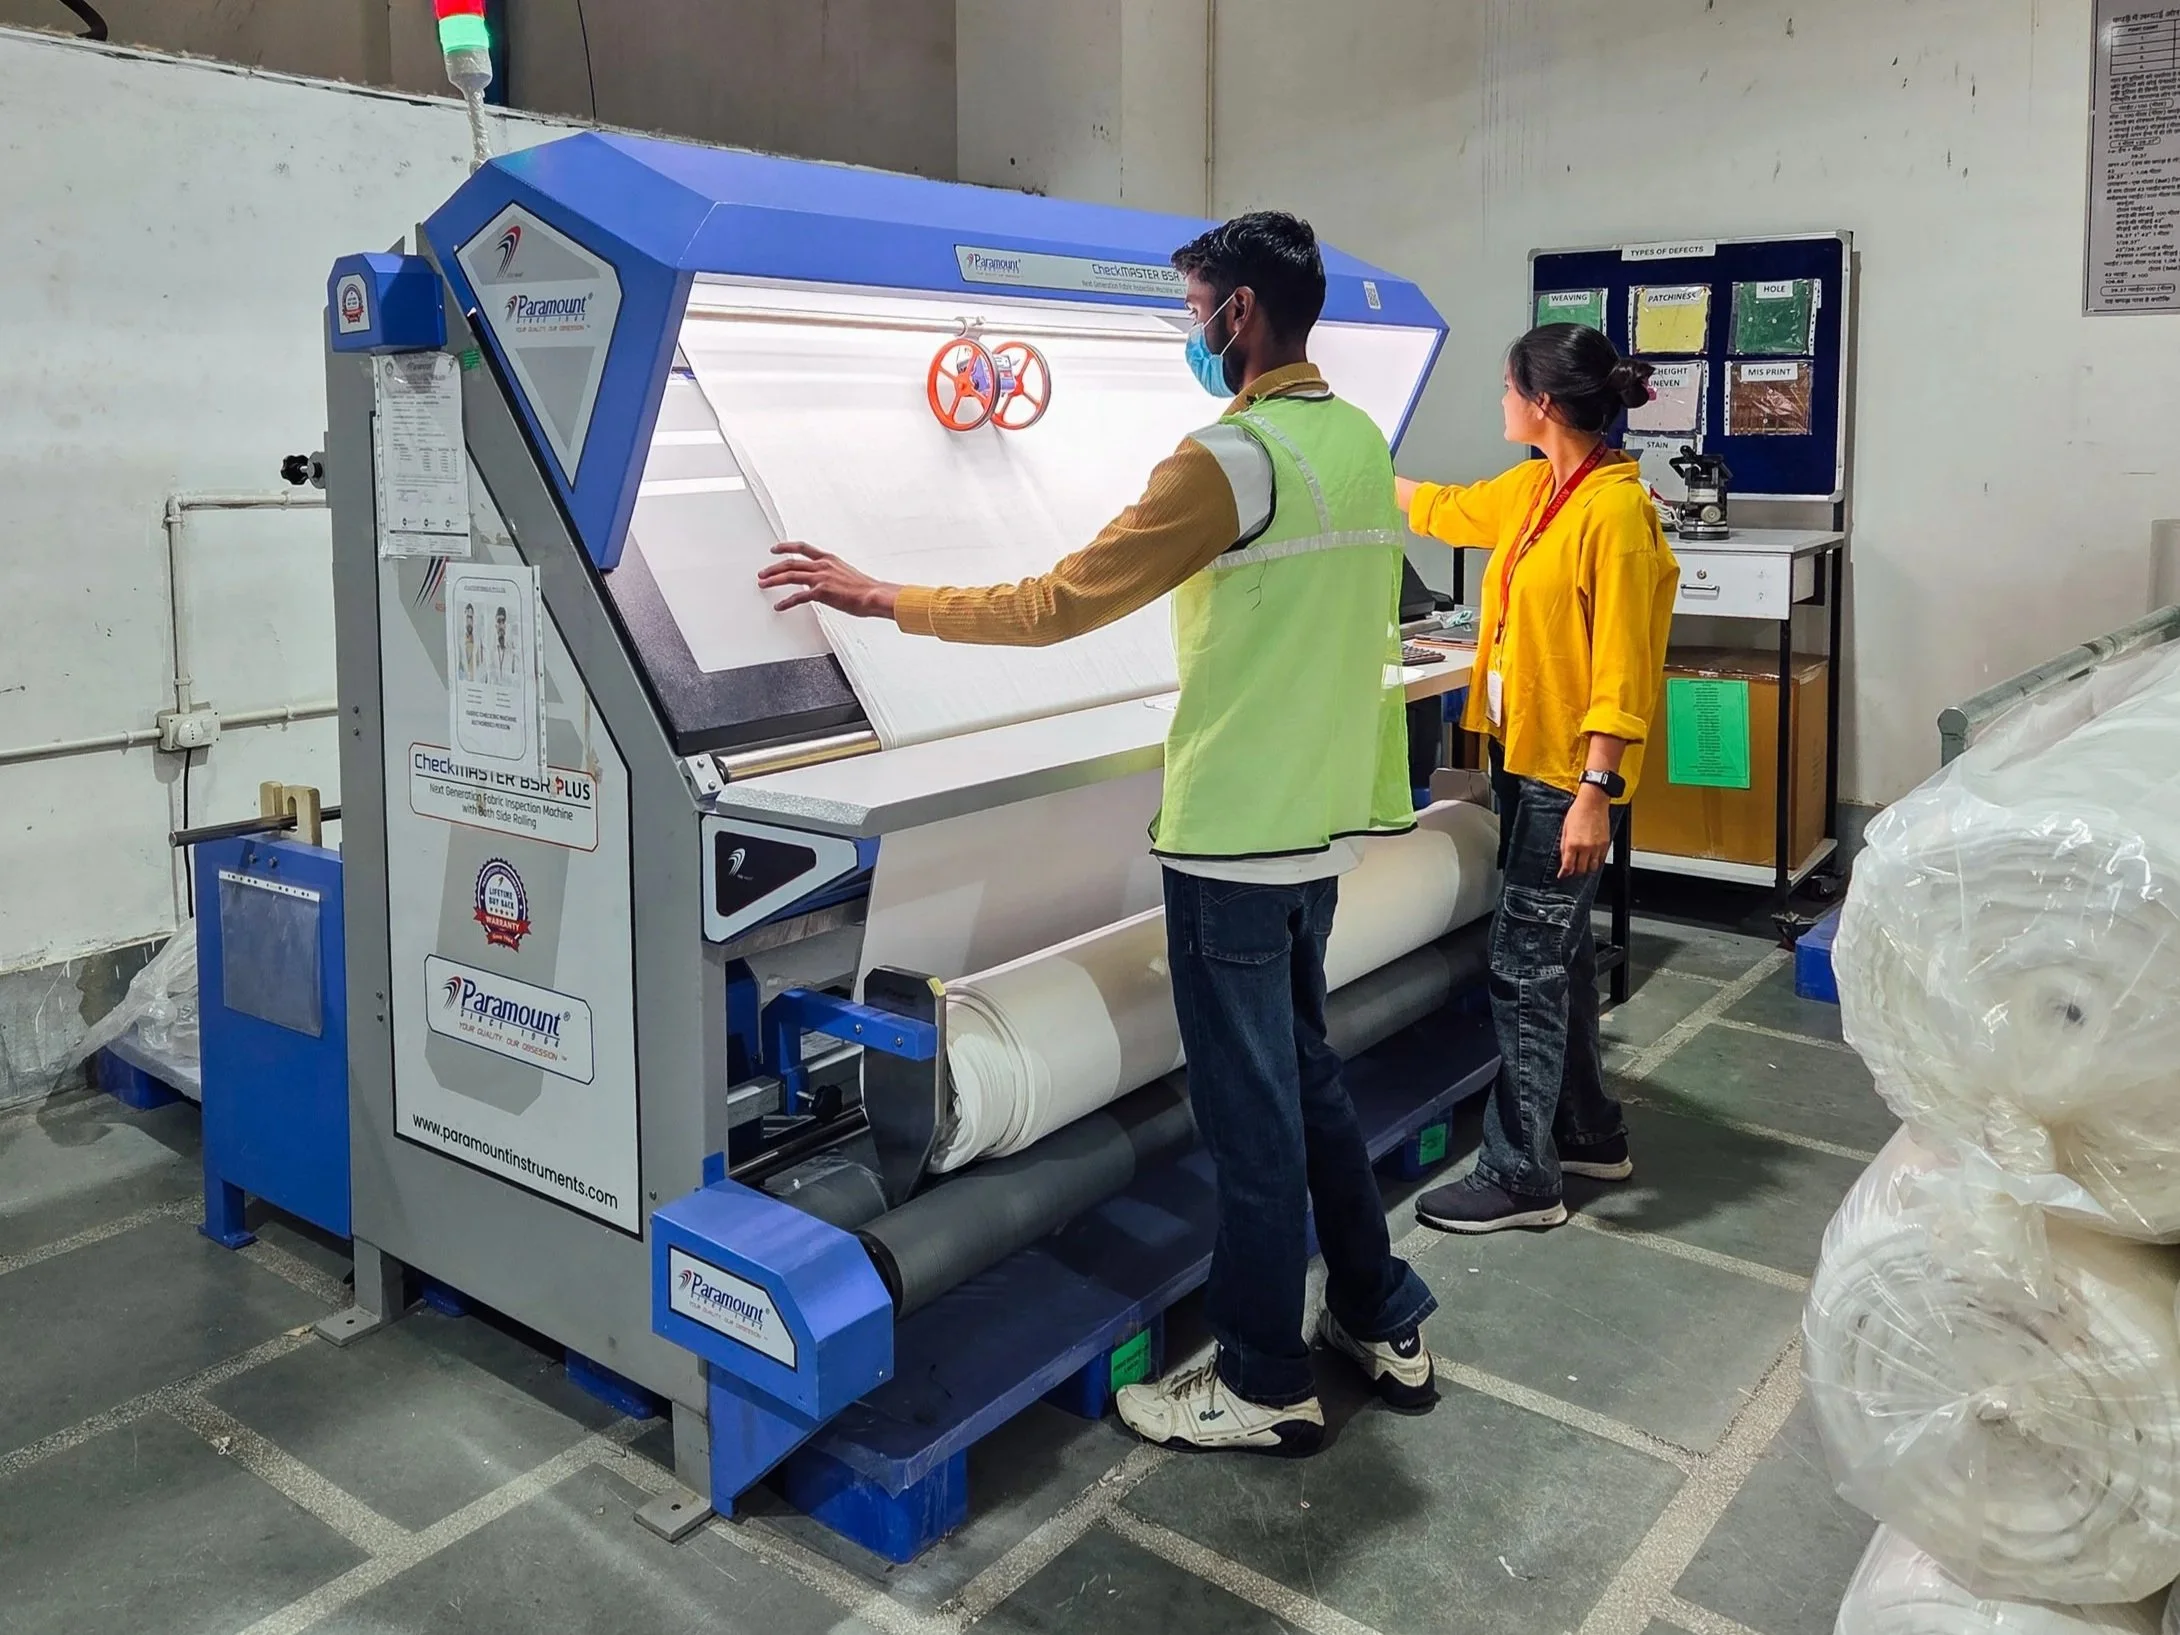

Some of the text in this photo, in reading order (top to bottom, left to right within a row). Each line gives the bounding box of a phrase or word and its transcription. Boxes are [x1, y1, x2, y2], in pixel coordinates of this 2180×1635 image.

[1631, 249, 1655, 257] TYPES
[1669, 245, 1704, 254] DEFECTS
[974, 254, 1019, 271] Paramount
[1161, 270, 1180, 281] BSR
[1551, 294, 1588, 303] WEAVING
[1763, 285, 1786, 293] HOLE
[516, 294, 587, 319] Paramount
[1766, 368, 1792, 376] PRINT
[1646, 441, 1669, 449] STAIN
[556, 777, 591, 800] PLUS
[430, 784, 574, 822] Next Generation Fabric Inspection Machine
[462, 804, 537, 830] with Both Side Rolling
[486, 915, 520, 931] WARRANTY
[461, 978, 561, 1037] Paramount
[460, 1010, 503, 1030] SINCE
[459, 1022, 558, 1061] YOUR QUALITY OUR OBSESSION
[412, 1113, 619, 1210] www.paramountinstruments.com
[691, 1271, 764, 1324] Paramount
